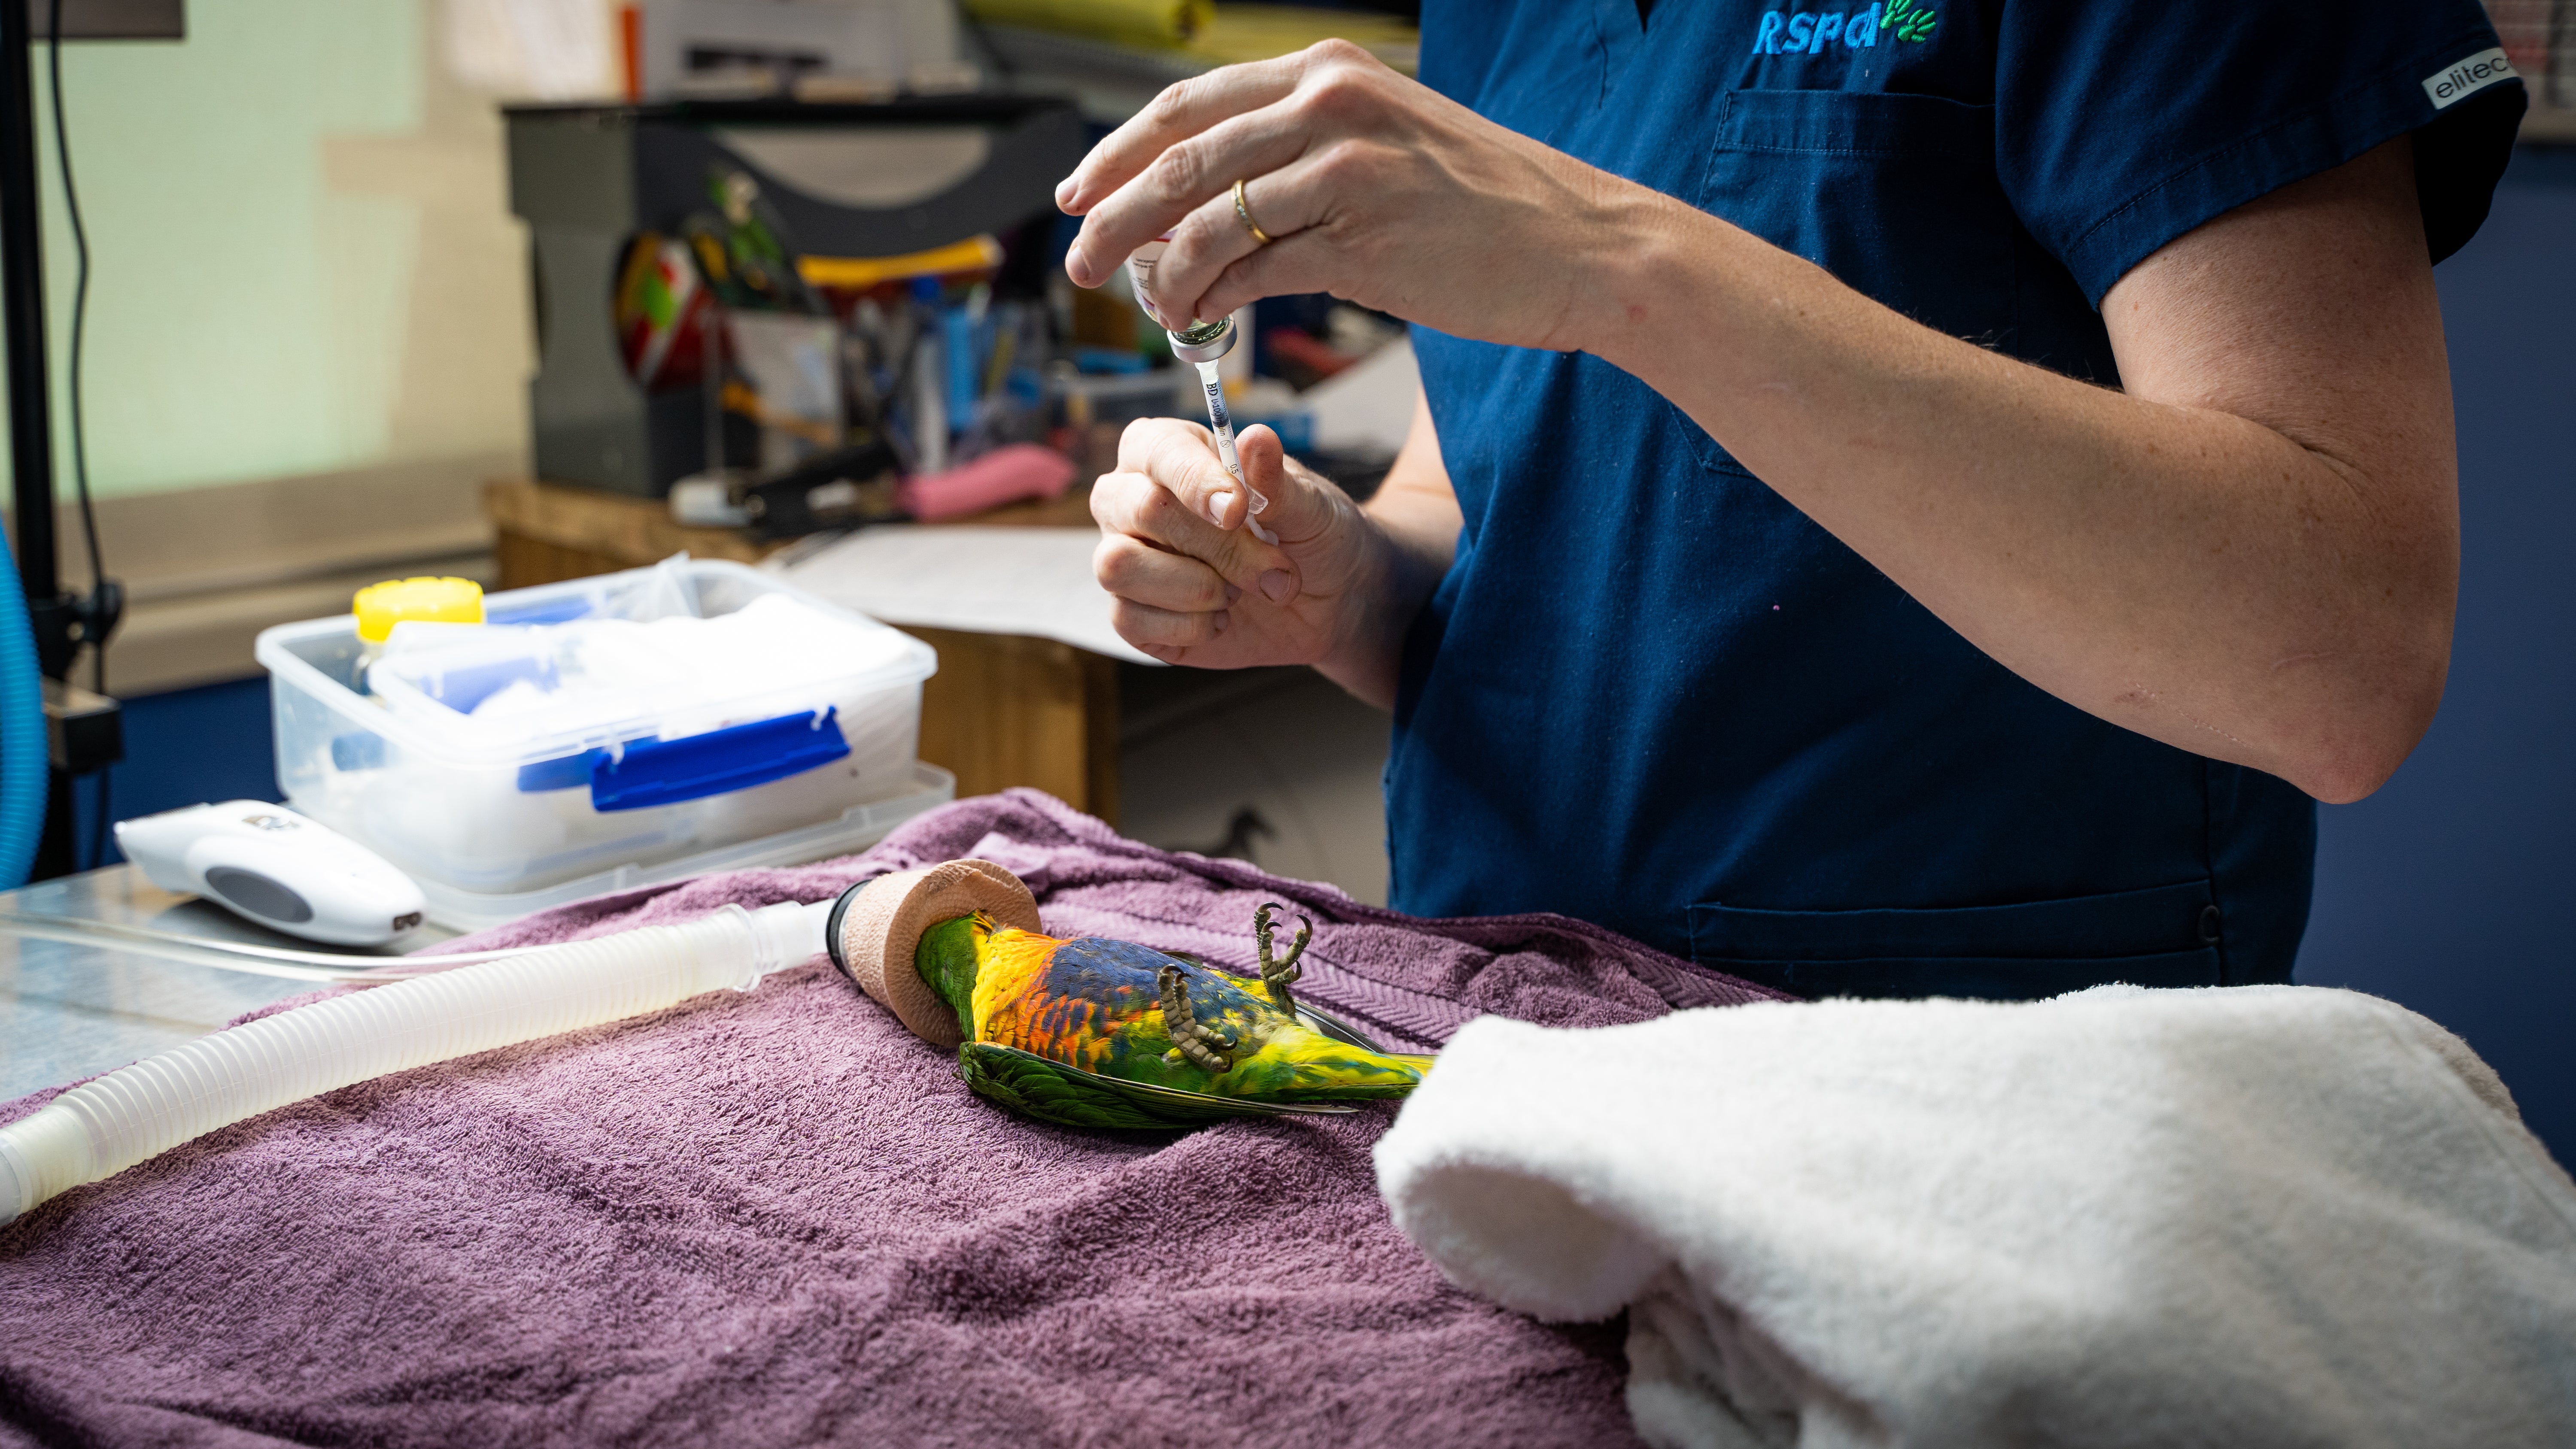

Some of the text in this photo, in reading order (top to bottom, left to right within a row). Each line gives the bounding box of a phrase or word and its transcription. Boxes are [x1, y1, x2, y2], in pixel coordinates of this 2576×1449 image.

[2436, 58, 2512, 98] elitec
[1206, 382, 1226, 436] BD U-100 Insulin
[1230, 464, 1239, 474] 0.5
